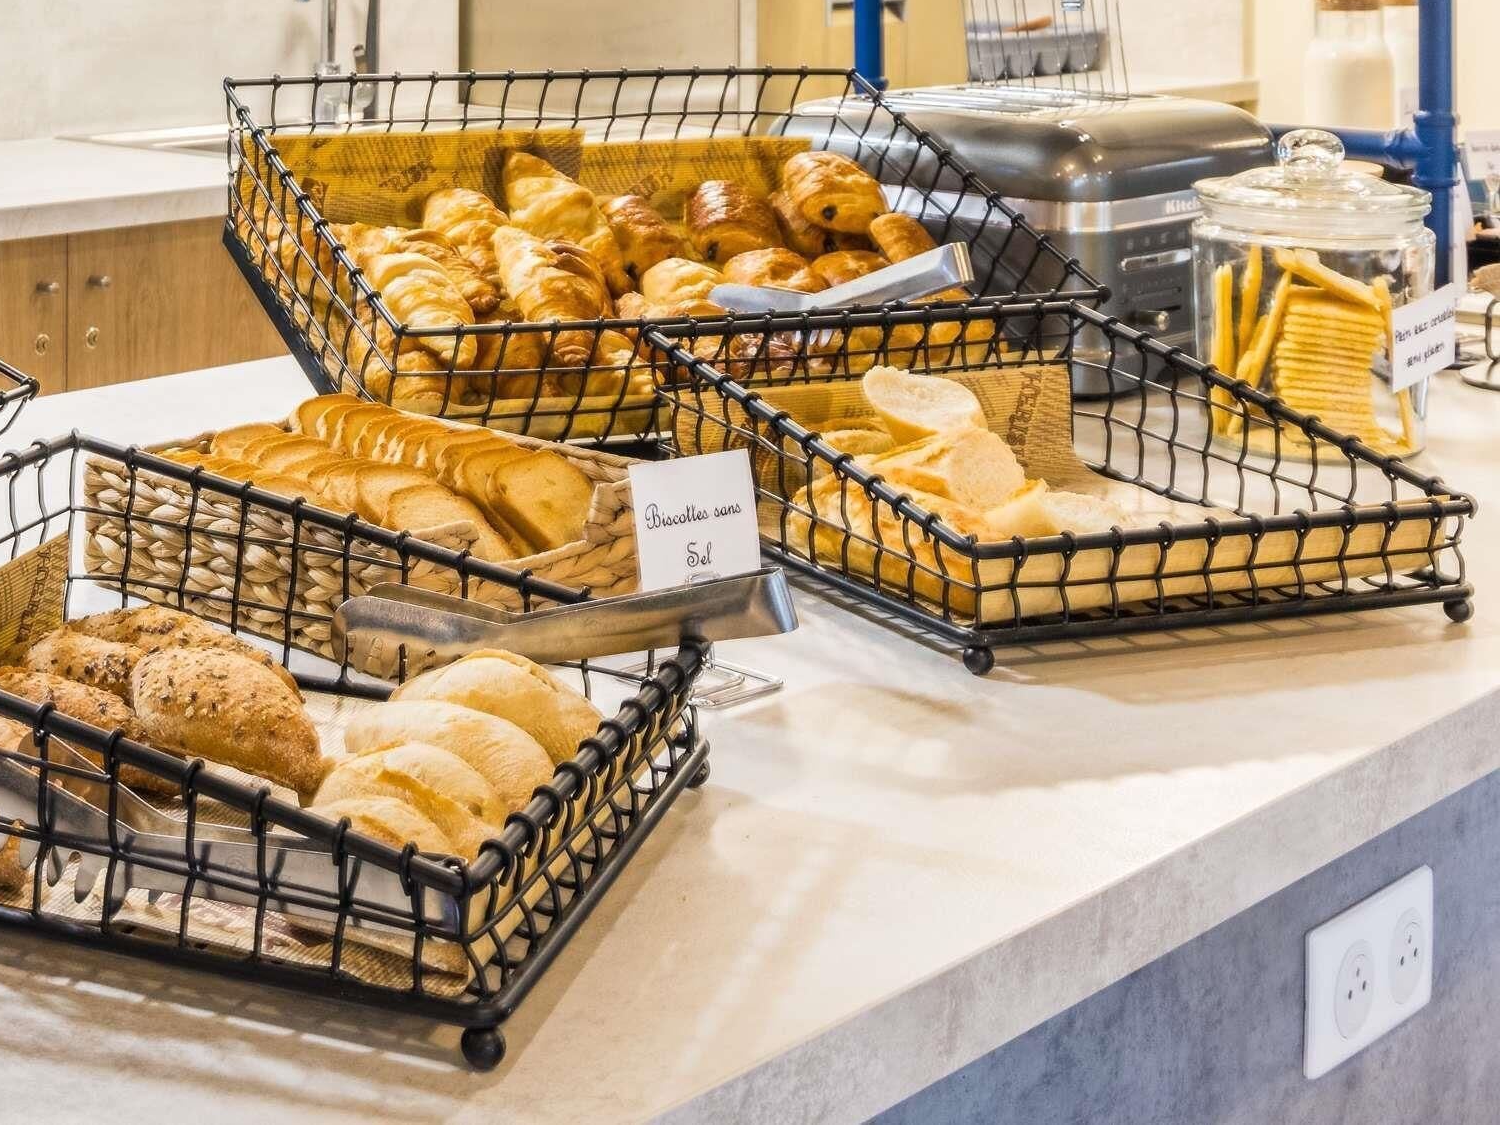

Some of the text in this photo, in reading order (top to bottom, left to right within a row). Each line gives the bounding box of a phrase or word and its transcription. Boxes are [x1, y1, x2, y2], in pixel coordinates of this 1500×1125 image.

[644, 501, 742, 530] Biscottes sans
[686, 540, 712, 567] Sel
